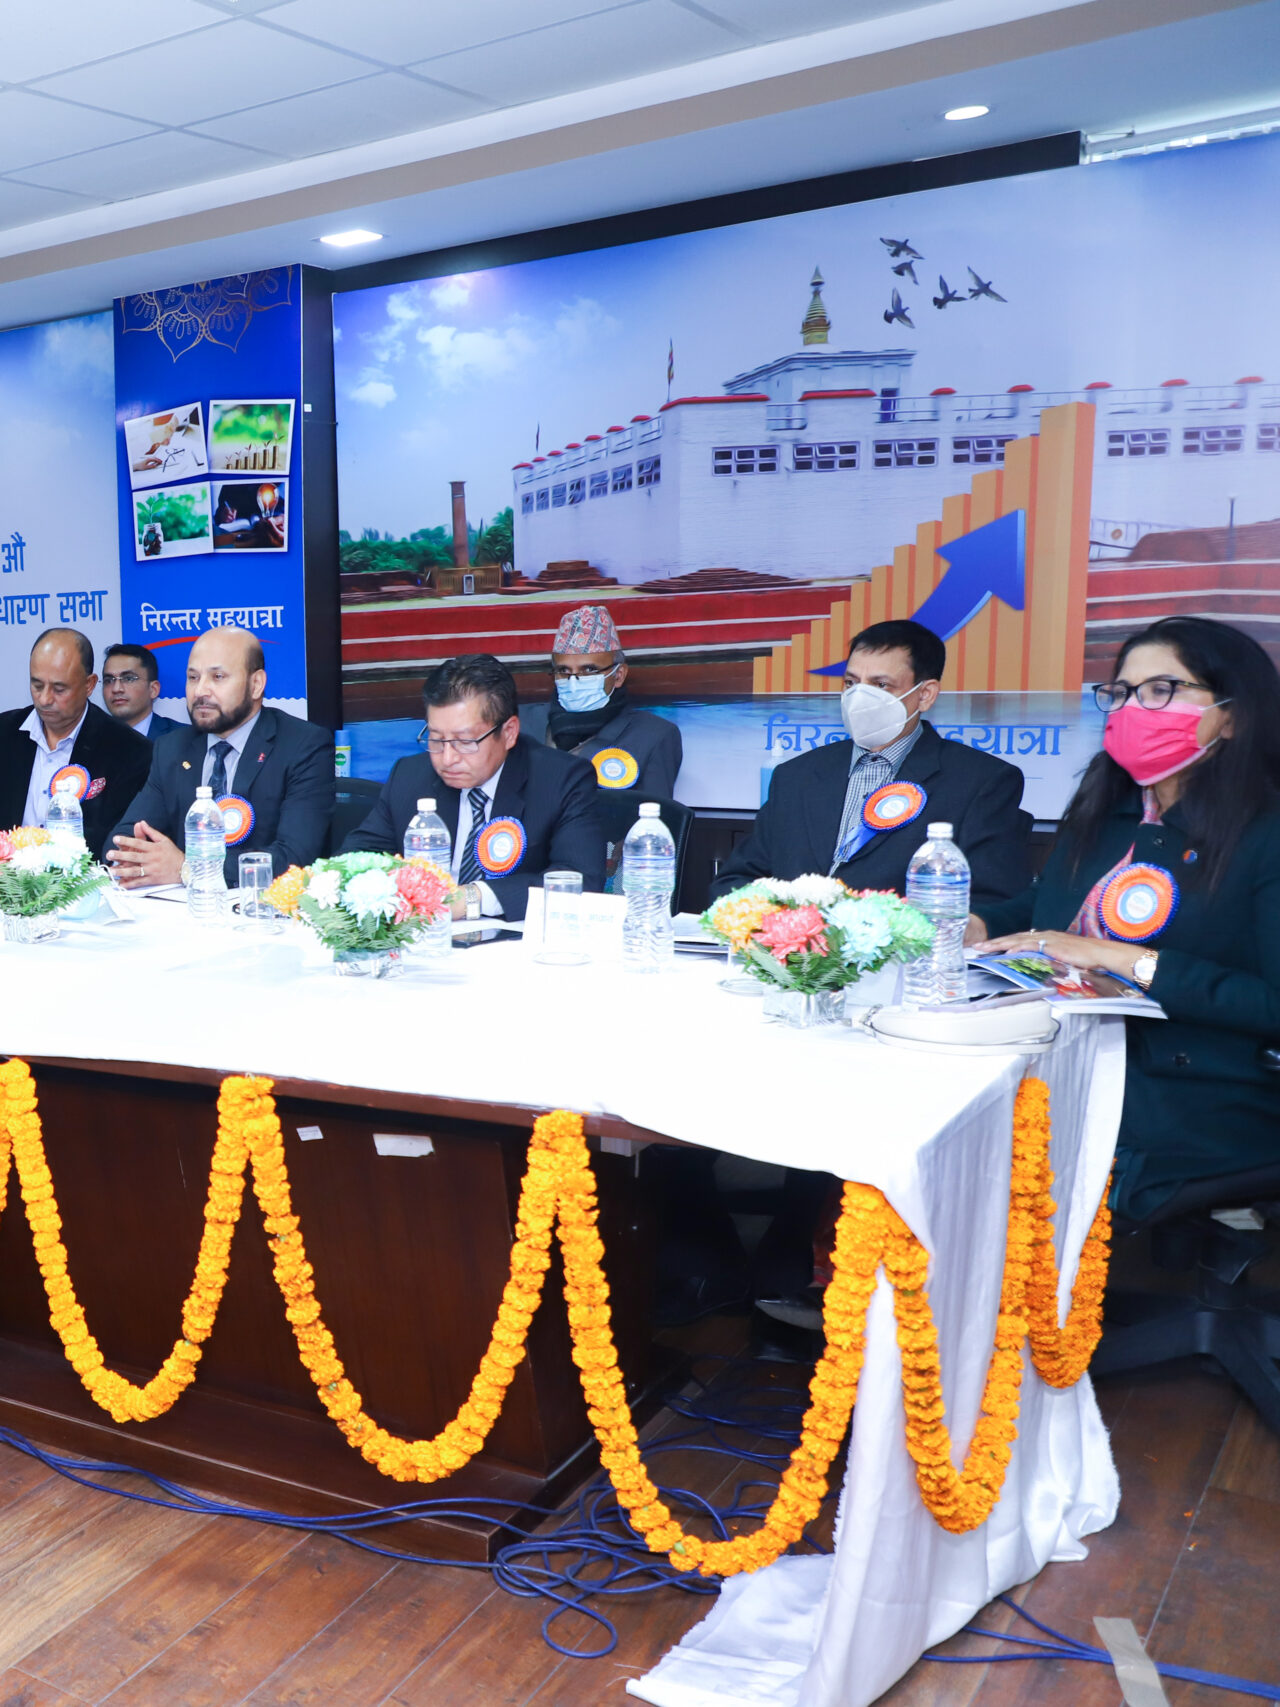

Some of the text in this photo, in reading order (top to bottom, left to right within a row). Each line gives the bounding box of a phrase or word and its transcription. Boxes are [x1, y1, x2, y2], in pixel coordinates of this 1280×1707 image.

[56, 590, 108, 623] सभा
[140, 602, 284, 632] निरन्तर सहयात्रा
